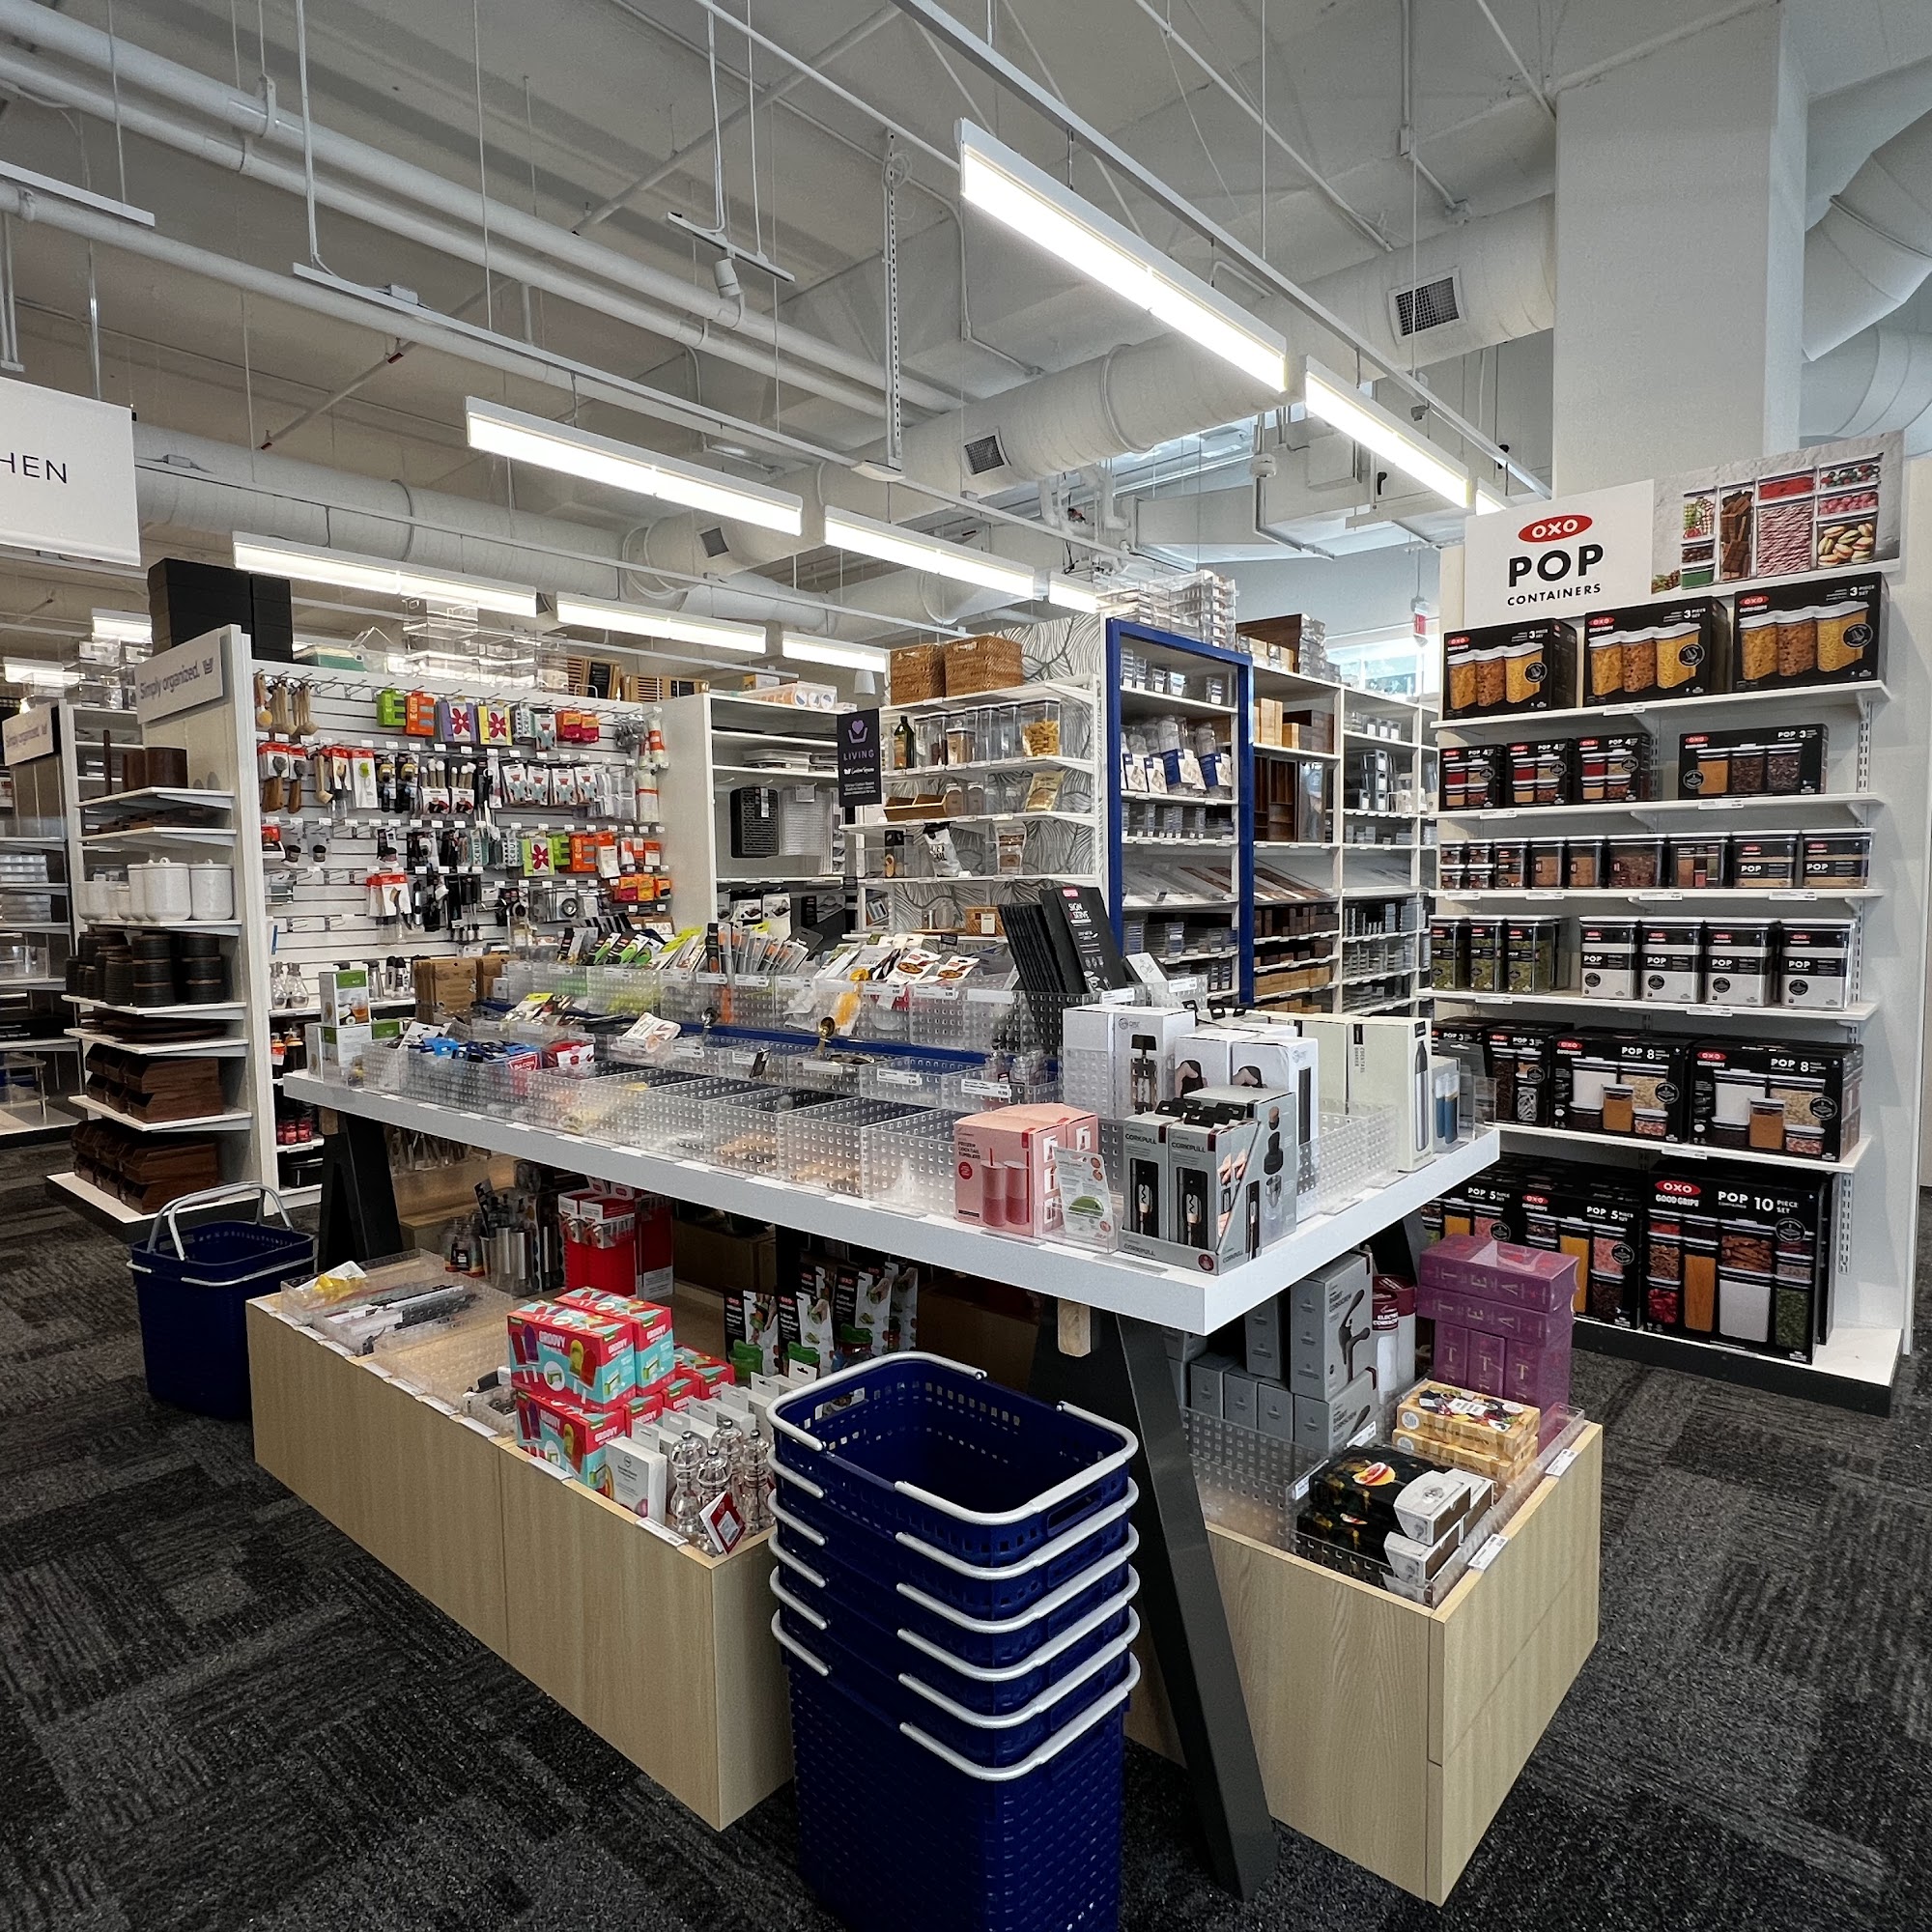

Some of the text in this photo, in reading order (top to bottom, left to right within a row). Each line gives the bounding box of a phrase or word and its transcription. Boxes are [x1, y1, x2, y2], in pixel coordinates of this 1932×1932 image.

[1531, 519, 1578, 539] OXO
[1508, 543, 1605, 588] POP
[1507, 583, 1602, 607] CONTAINERS
[1849, 586, 1859, 597] 3
[1684, 610, 1691, 619] 3
[843, 749, 875, 761] LIVING
[1621, 1046, 1655, 1060] POP 8
[1771, 1059, 1809, 1072] POP 8
[1124, 1133, 1157, 1145] CORKPULL
[1171, 1142, 1206, 1153] CORKPULL
[1467, 1187, 1486, 1196] POP
[1489, 1190, 1496, 1200] 5
[1663, 1182, 1692, 1194] OXO
[1718, 1191, 1748, 1204] POP
[1754, 1197, 1775, 1211] 10
[1586, 1206, 1606, 1215] POP
[1610, 1209, 1619, 1220] 5
[1776, 1206, 1790, 1214] SET
[1123, 1243, 1156, 1257] CORKPULL
